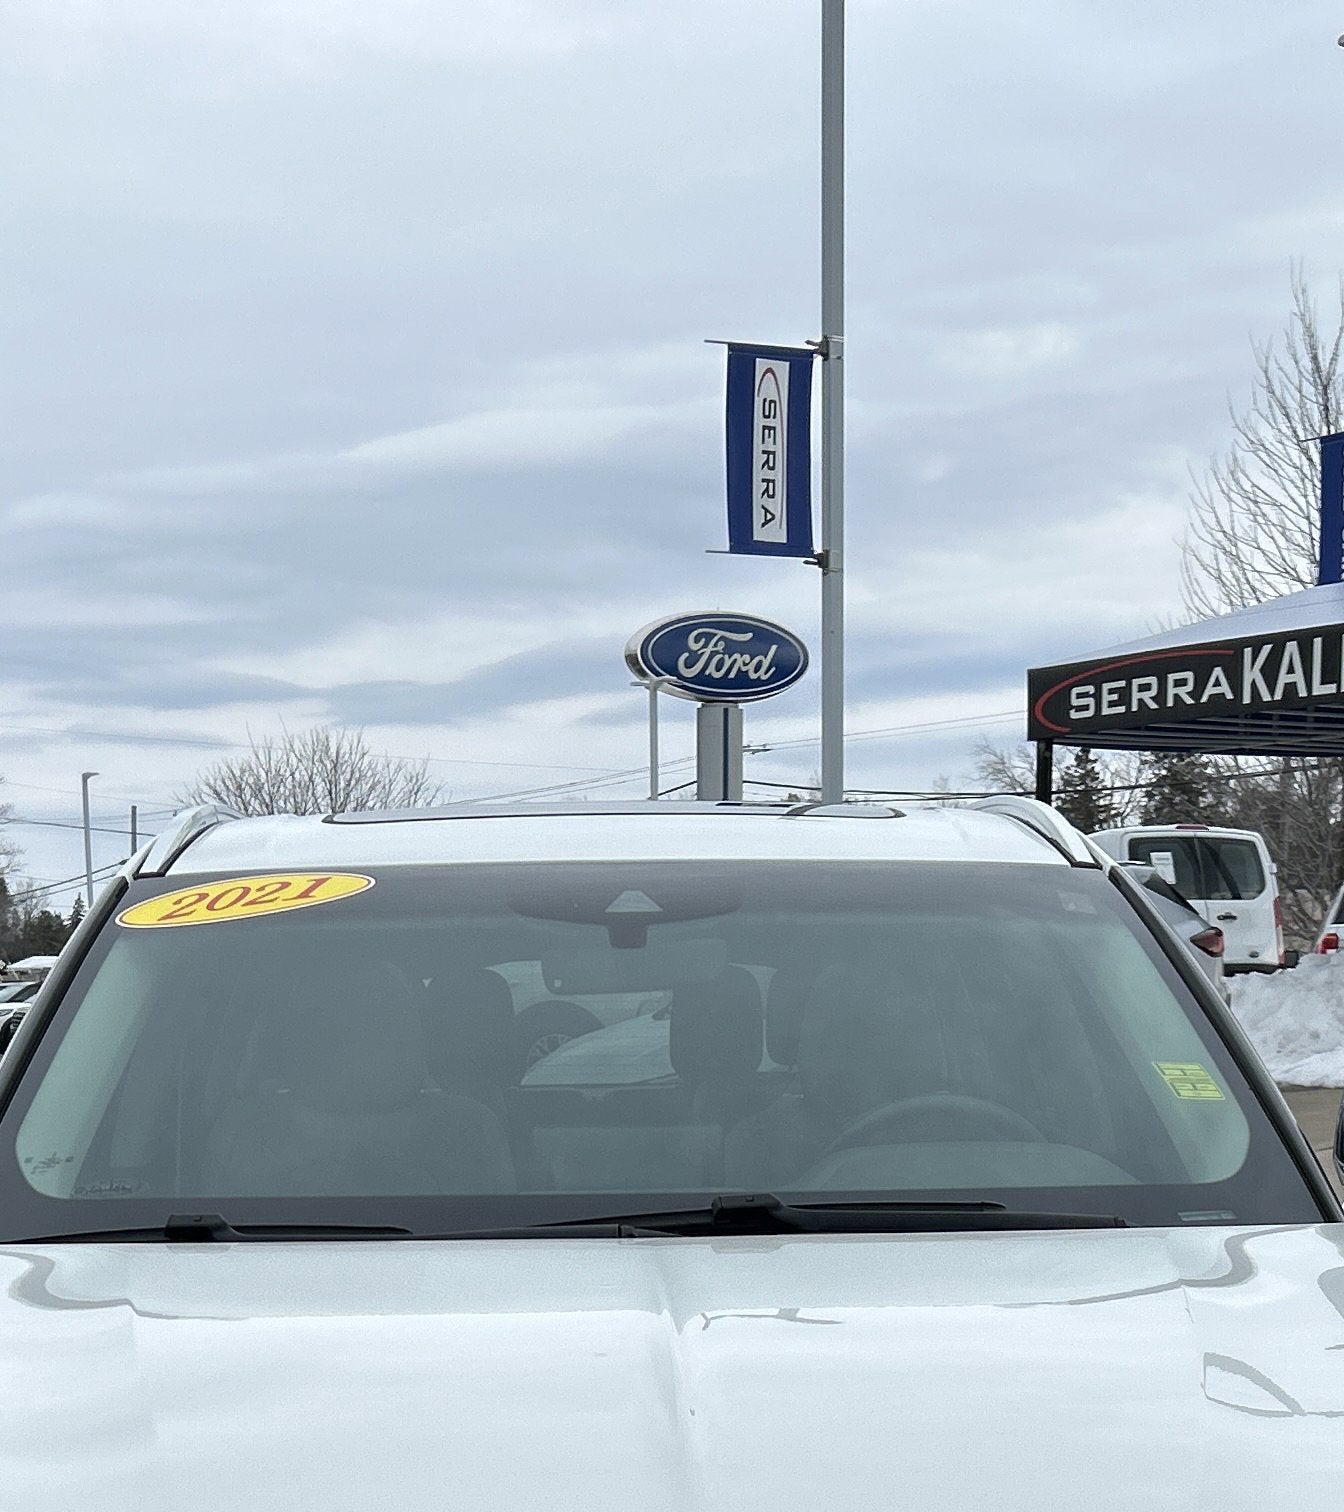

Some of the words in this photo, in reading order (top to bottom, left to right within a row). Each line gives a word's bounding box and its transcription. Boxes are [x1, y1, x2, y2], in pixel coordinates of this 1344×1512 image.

[760, 397, 777, 529] SERRA
[676, 627, 779, 681] Ford
[1068, 665, 1236, 720] SERRA
[156, 876, 334, 922] 2021
